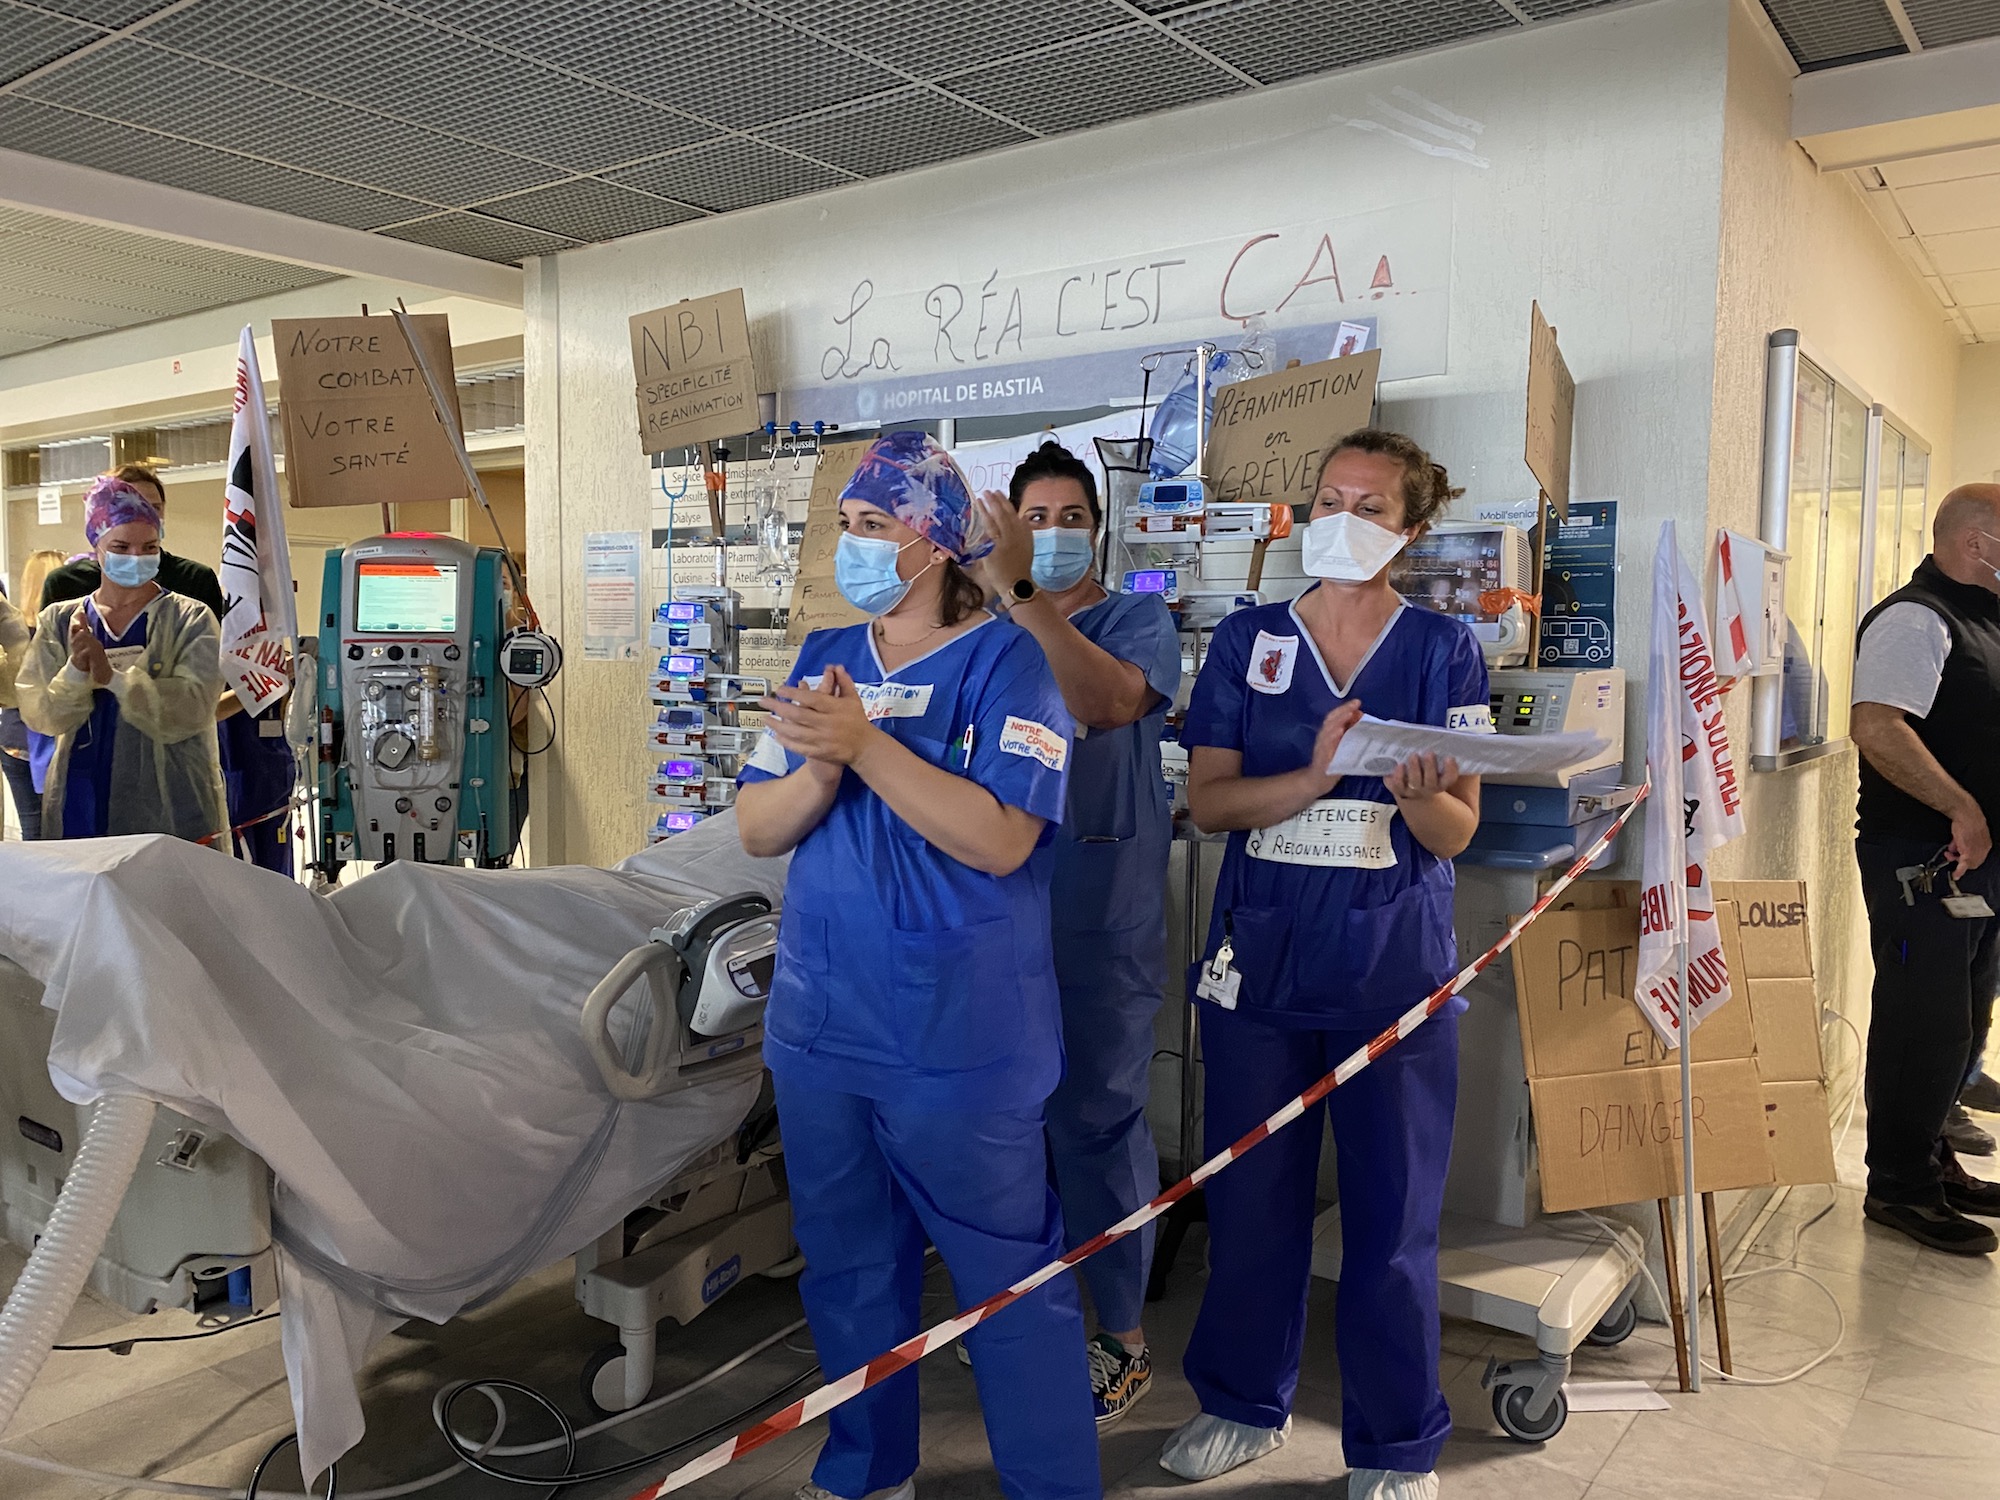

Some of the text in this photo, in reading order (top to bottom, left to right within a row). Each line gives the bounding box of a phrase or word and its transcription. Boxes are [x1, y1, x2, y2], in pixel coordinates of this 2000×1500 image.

[821, 280, 903, 380] La
[925, 268, 1024, 363] RÉA
[1057, 259, 1186, 336] C'EST
[291, 328, 381, 357] NOTRE
[641, 308, 724, 376] NBI
[318, 368, 415, 389] COMBAT
[956, 384, 977, 401] DE
[982, 377, 1044, 399] BASTIA
[1215, 369, 1364, 428] RÉANIMATION
[301, 411, 395, 440] VOTRE
[648, 393, 744, 433] REANIMATION
[1264, 428, 1291, 449] en
[329, 442, 410, 475] SANTÉ
[1217, 449, 1320, 500] GRÈVE
[672, 512, 701, 525] Dialyse
[673, 550, 759, 564] Laboratoir Pharma
[673, 572, 702, 584] Cuisine
[1011, 722, 1043, 736] NOTRE
[1003, 740, 1031, 755] VOTRE
[1299, 808, 1379, 823] PETENCES
[1580, 1096, 1713, 1157] DANGER
